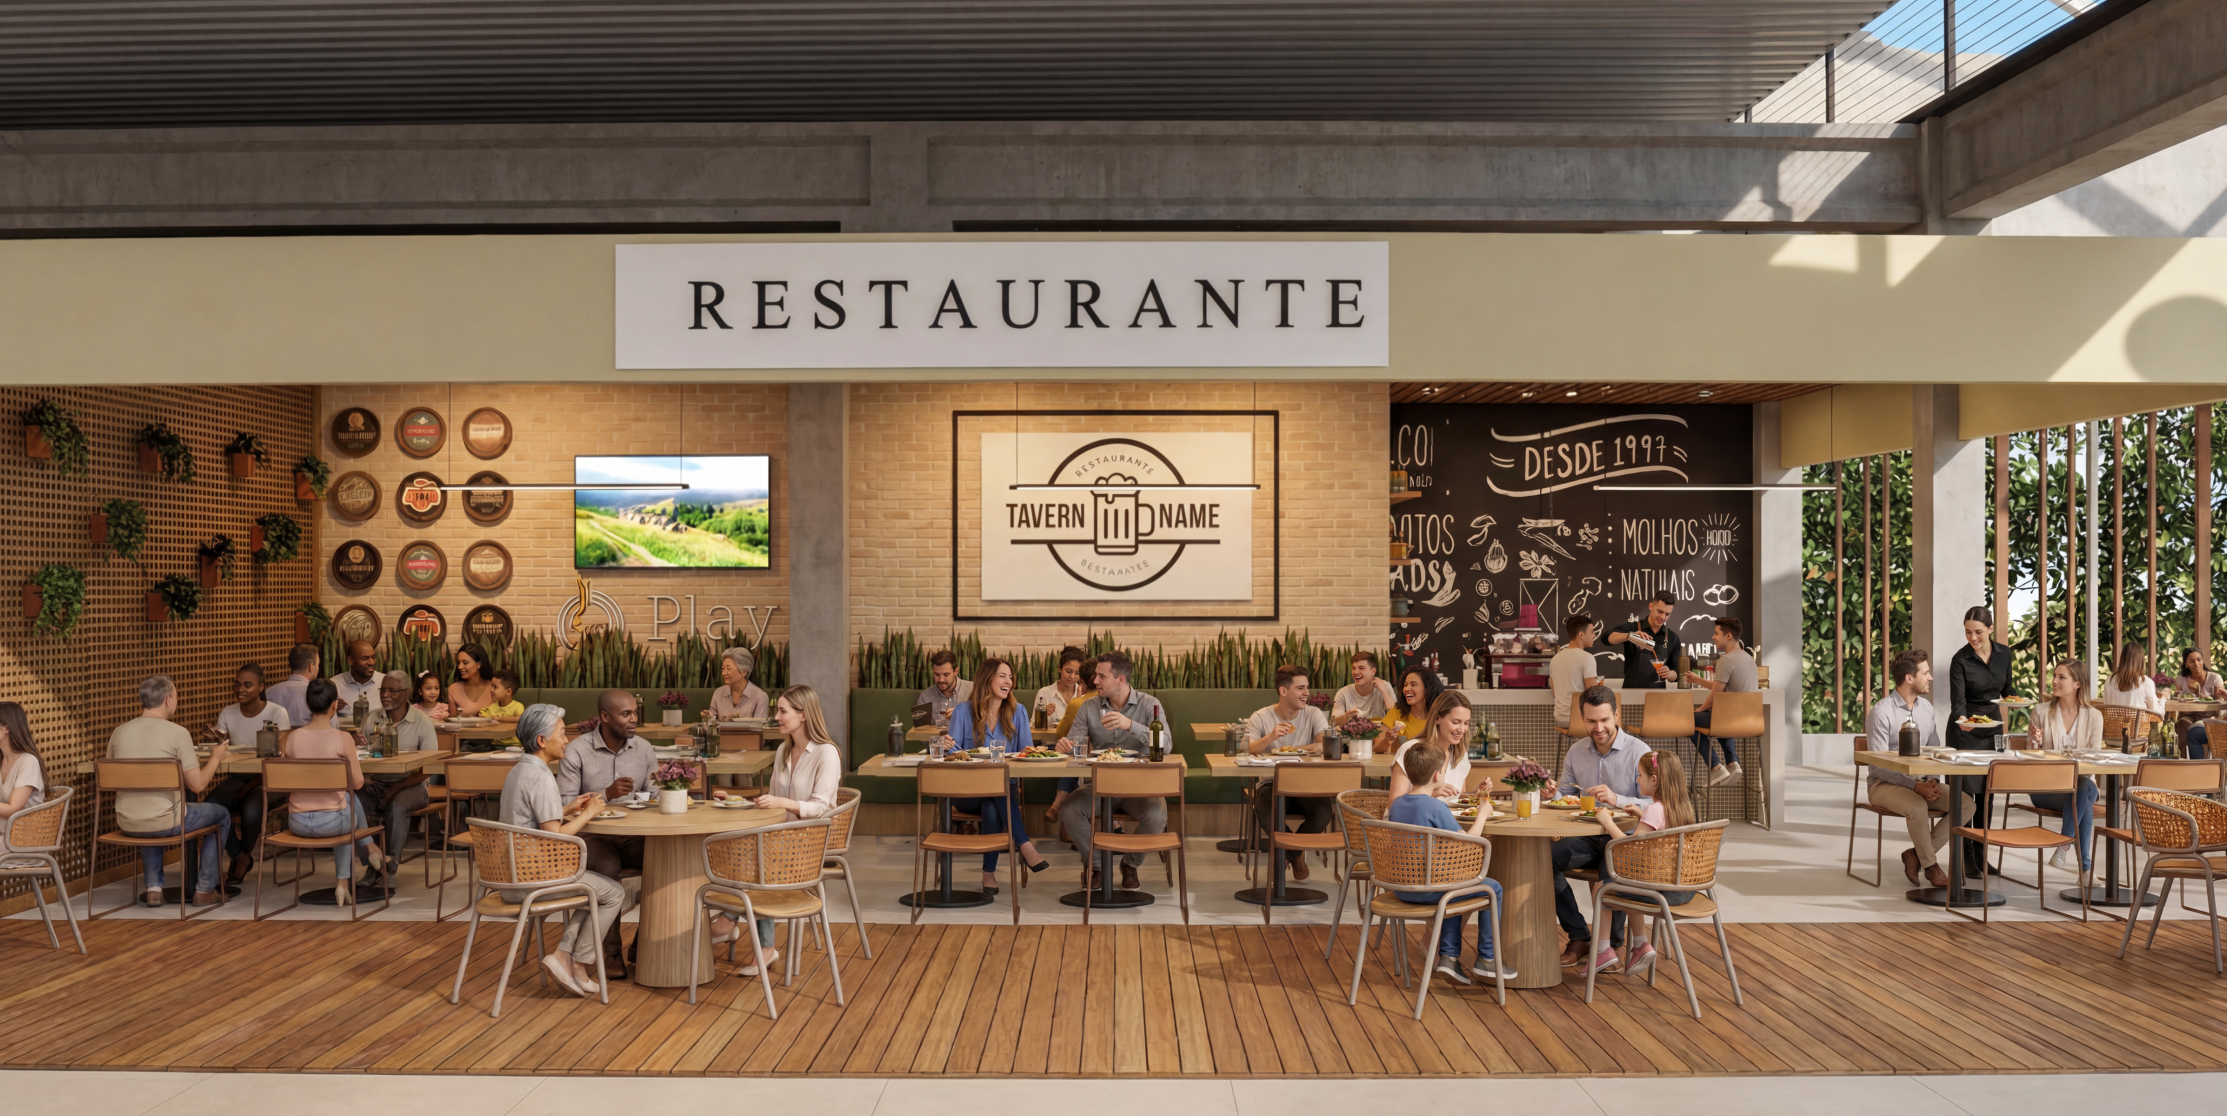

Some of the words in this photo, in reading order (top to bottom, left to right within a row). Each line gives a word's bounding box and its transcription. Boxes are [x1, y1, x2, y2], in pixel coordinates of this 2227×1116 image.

[687, 278, 1366, 331] RESTAURANTE
[1075, 454, 1155, 478] RESTAURANTE
[1524, 440, 1605, 481] DESDE
[1613, 434, 1667, 466] 1997
[1006, 503, 1085, 529] TAVERN
[1159, 503, 1220, 529] NAME
[1623, 518, 1699, 556] MOLHOS
[647, 594, 778, 651] Play
